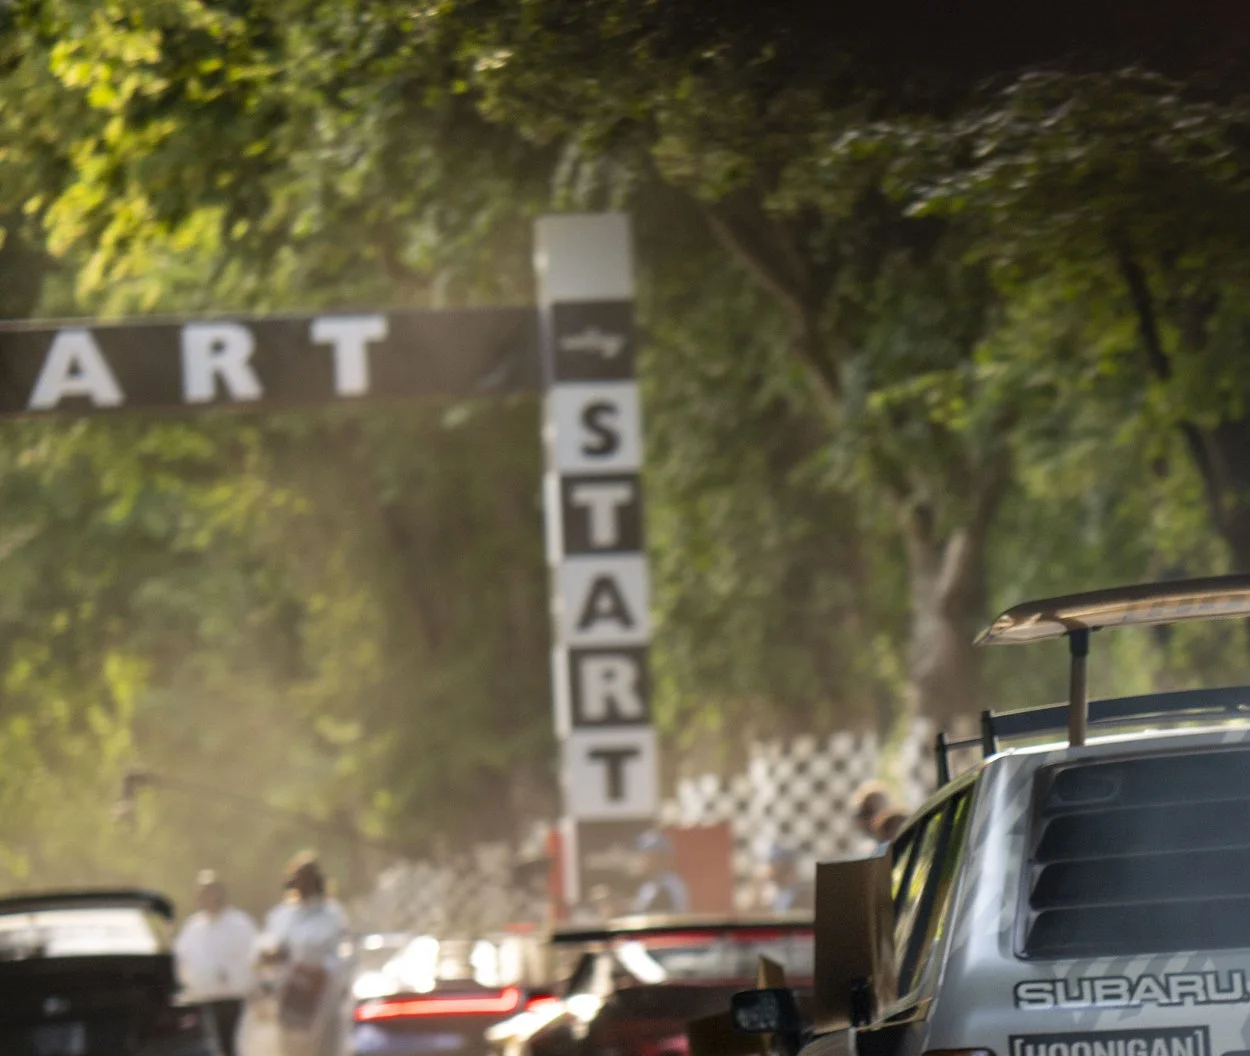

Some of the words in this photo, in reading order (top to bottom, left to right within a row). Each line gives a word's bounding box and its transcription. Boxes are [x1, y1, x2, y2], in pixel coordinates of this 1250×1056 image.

[27, 313, 388, 411] ART
[571, 400, 642, 805] START
[1014, 970, 1248, 1009] SUBARU
